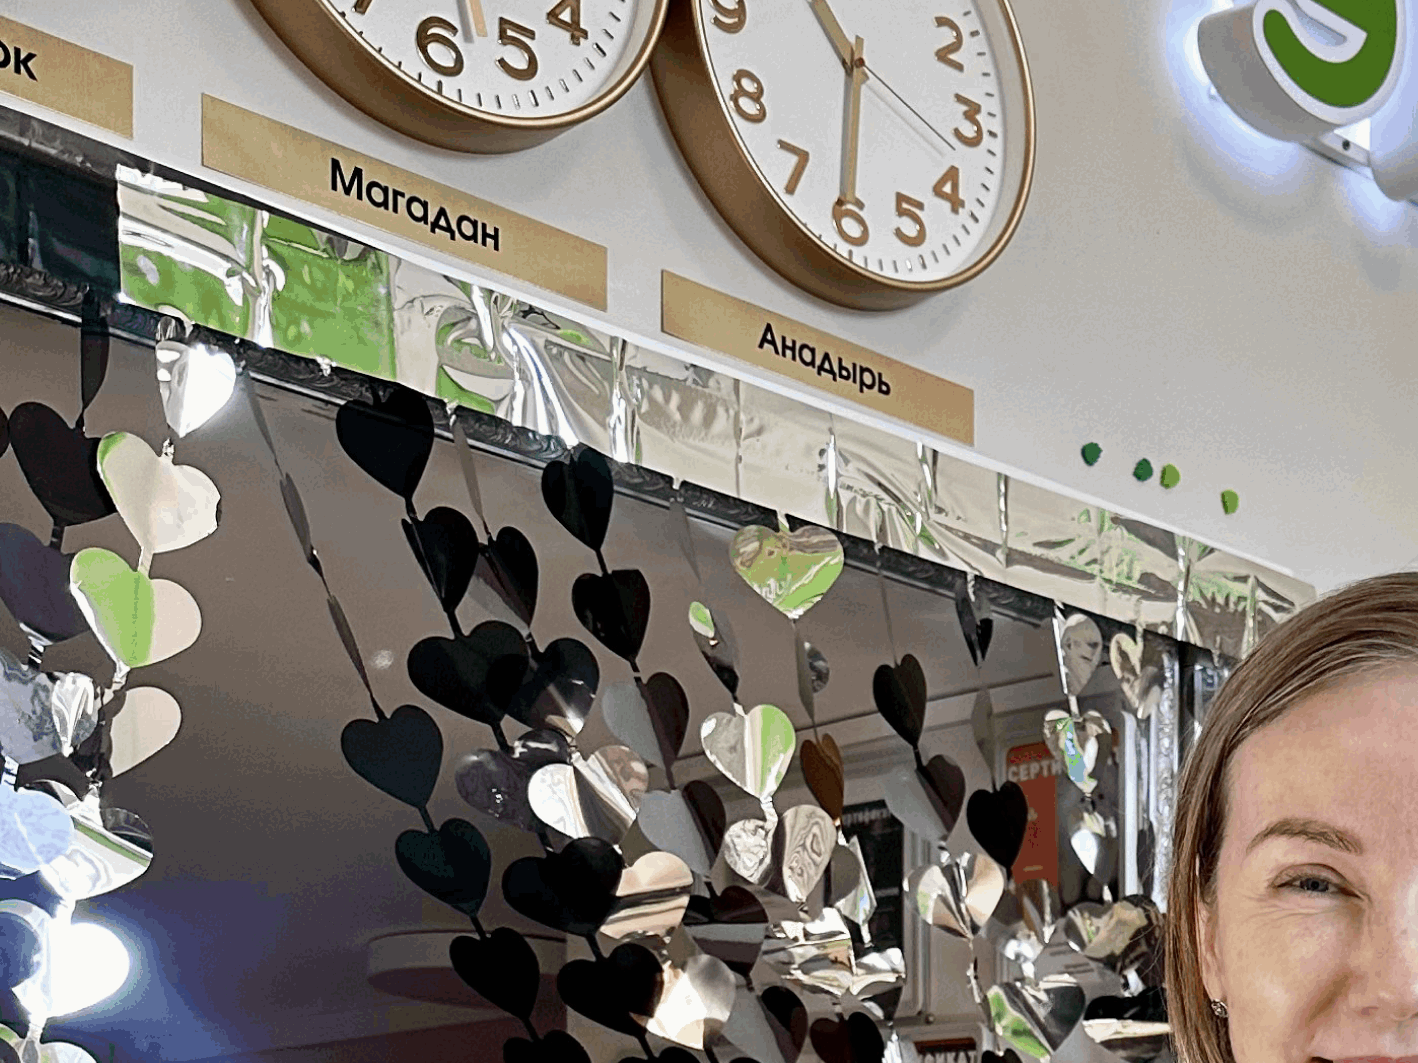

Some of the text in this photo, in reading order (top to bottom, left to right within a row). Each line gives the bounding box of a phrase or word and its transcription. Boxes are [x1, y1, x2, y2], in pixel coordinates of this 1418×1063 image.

[416, 16, 464, 77] 6
[495, 17, 538, 81] 5
[546, 0, 589, 46] 4
[934, 16, 965, 73] 2
[730, 69, 767, 124] 8
[953, 93, 984, 147] 3
[777, 139, 810, 196] 7
[932, 165, 965, 215] 4
[330, 157, 500, 252] Магадан
[832, 196, 869, 247] 6
[894, 191, 927, 248] 5
[758, 322, 891, 395] Анадырь
[1008, 757, 1063, 783] СЕРТИ
